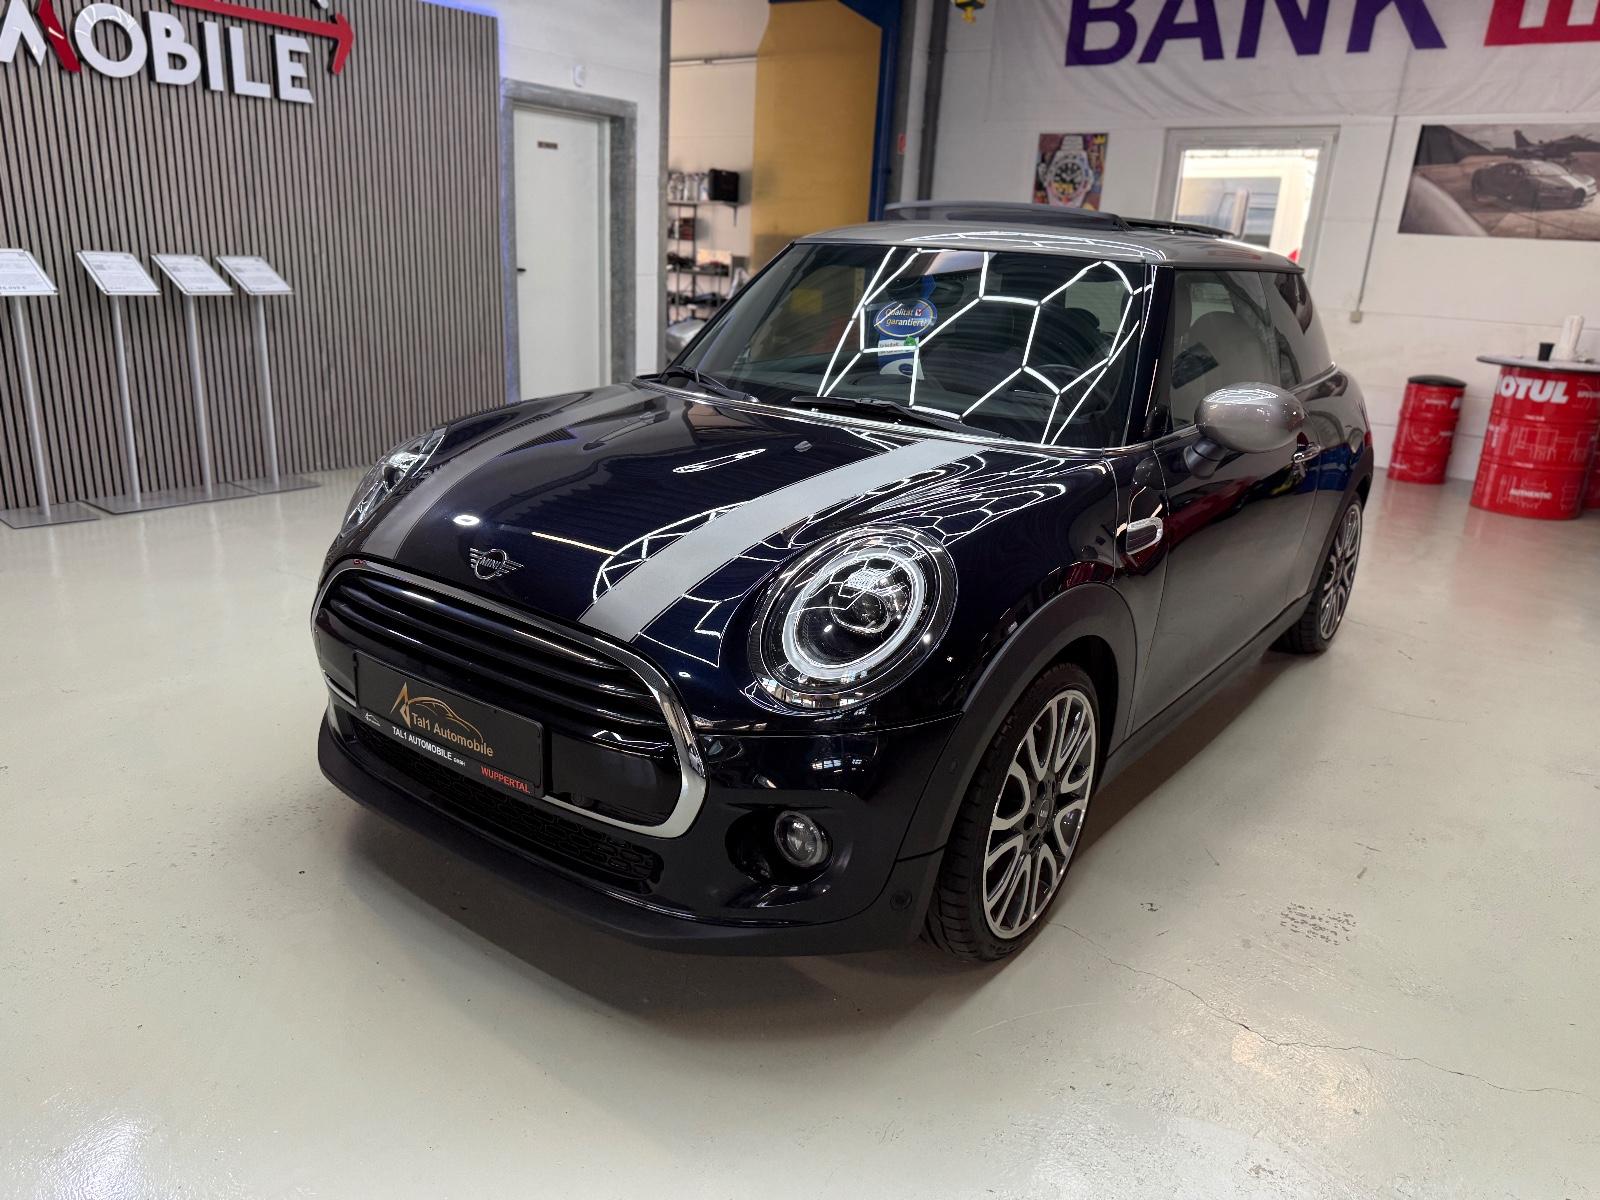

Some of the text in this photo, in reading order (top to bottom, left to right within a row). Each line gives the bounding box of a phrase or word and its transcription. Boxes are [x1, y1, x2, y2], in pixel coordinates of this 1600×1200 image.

[1497, 374, 1569, 404] OTUL
[392, 726, 408, 740] TAL1
[408, 734, 453, 761] AUTOMOBILE
[411, 712, 494, 757] Tal1 Automobile
[481, 765, 532, 794] WUPPERTAL
